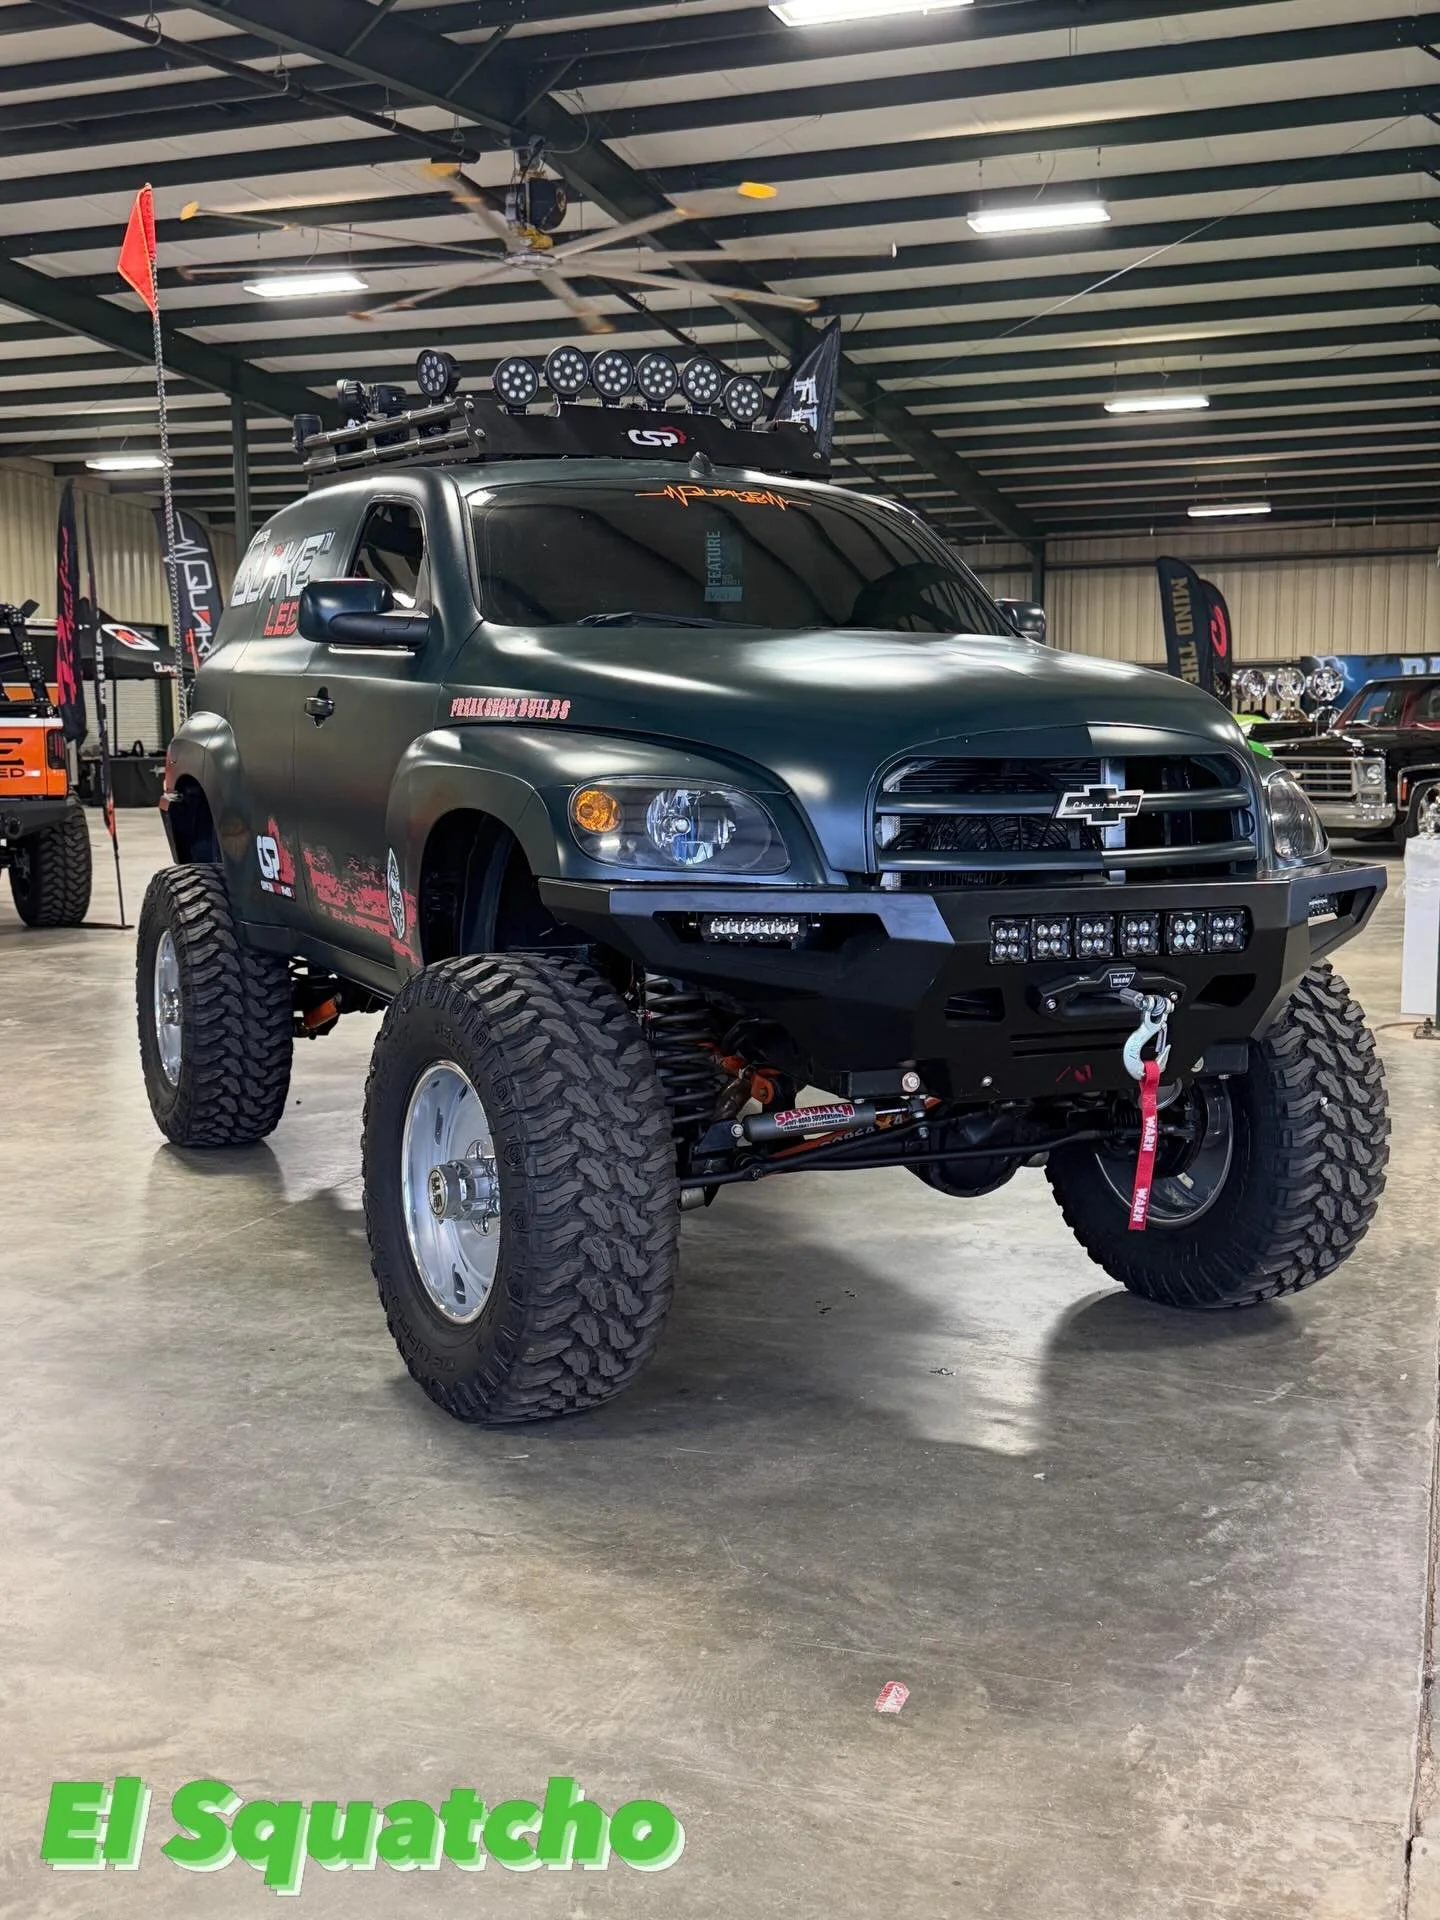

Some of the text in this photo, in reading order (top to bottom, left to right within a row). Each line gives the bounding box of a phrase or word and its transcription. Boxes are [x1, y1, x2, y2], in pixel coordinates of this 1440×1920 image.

[706, 531, 721, 587] FEATURE
[1170, 576, 1194, 635] MIND
[518, 698, 571, 719] BUILDS
[1073, 801, 1138, 811] Chevrolet
[775, 1104, 854, 1124] SASQUATCH
[1143, 1115, 1156, 1152] WARN
[1133, 1188, 1148, 1222] WARN
